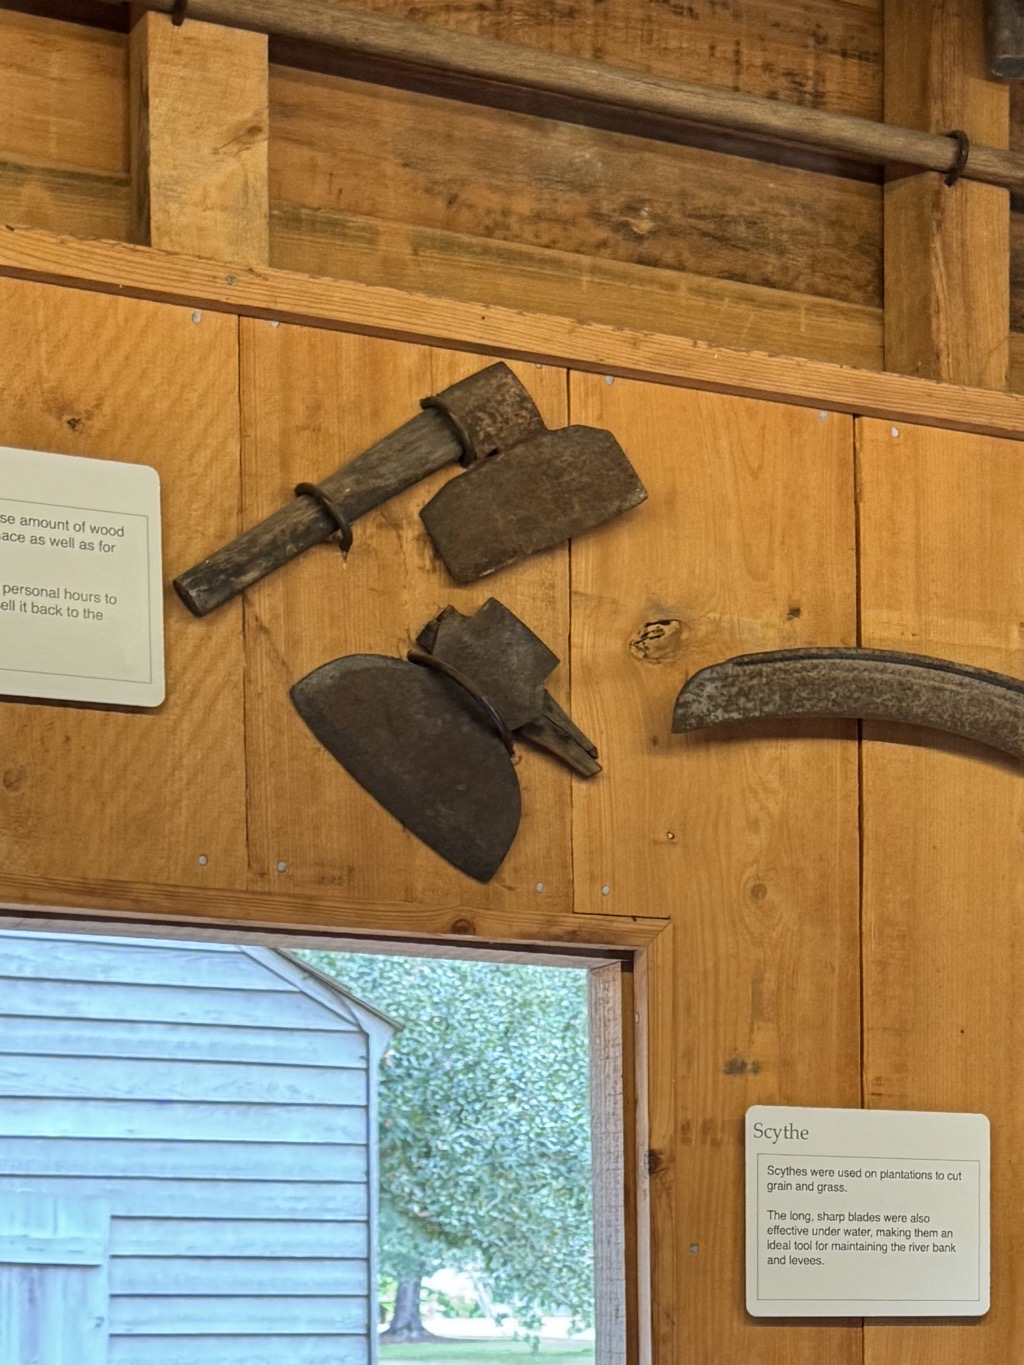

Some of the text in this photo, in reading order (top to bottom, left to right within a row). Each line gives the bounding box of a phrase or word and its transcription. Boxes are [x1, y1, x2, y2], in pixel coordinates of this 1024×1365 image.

[19, 516, 69, 530] amount
[72, 521, 86, 532] of
[89, 524, 124, 536] wood
[0, 533, 116, 552] ace as well as for
[2, 584, 117, 604] personal hours to
[0, 600, 103, 620] ell it back to the
[753, 1122, 809, 1144] Scythe
[766, 1166, 808, 1178] Scythes
[837, 1168, 862, 1178] used
[879, 1169, 933, 1180] plantations
[935, 1171, 944, 1180] to
[946, 1172, 962, 1180] cut
[766, 1181, 847, 1194] grain and grass.
[766, 1210, 787, 1220] The
[789, 1211, 814, 1223] long,
[816, 1211, 845, 1223] sharp
[847, 1212, 881, 1222] blades
[909, 1213, 930, 1223] also
[766, 1226, 809, 1235] effective
[811, 1226, 841, 1236] under
[842, 1227, 873, 1237] water,
[875, 1227, 911, 1239] making
[914, 1228, 938, 1237] them
[766, 1240, 956, 1254] ideal tool for maintaining the river bank
[766, 1255, 824, 1265] and levees.
